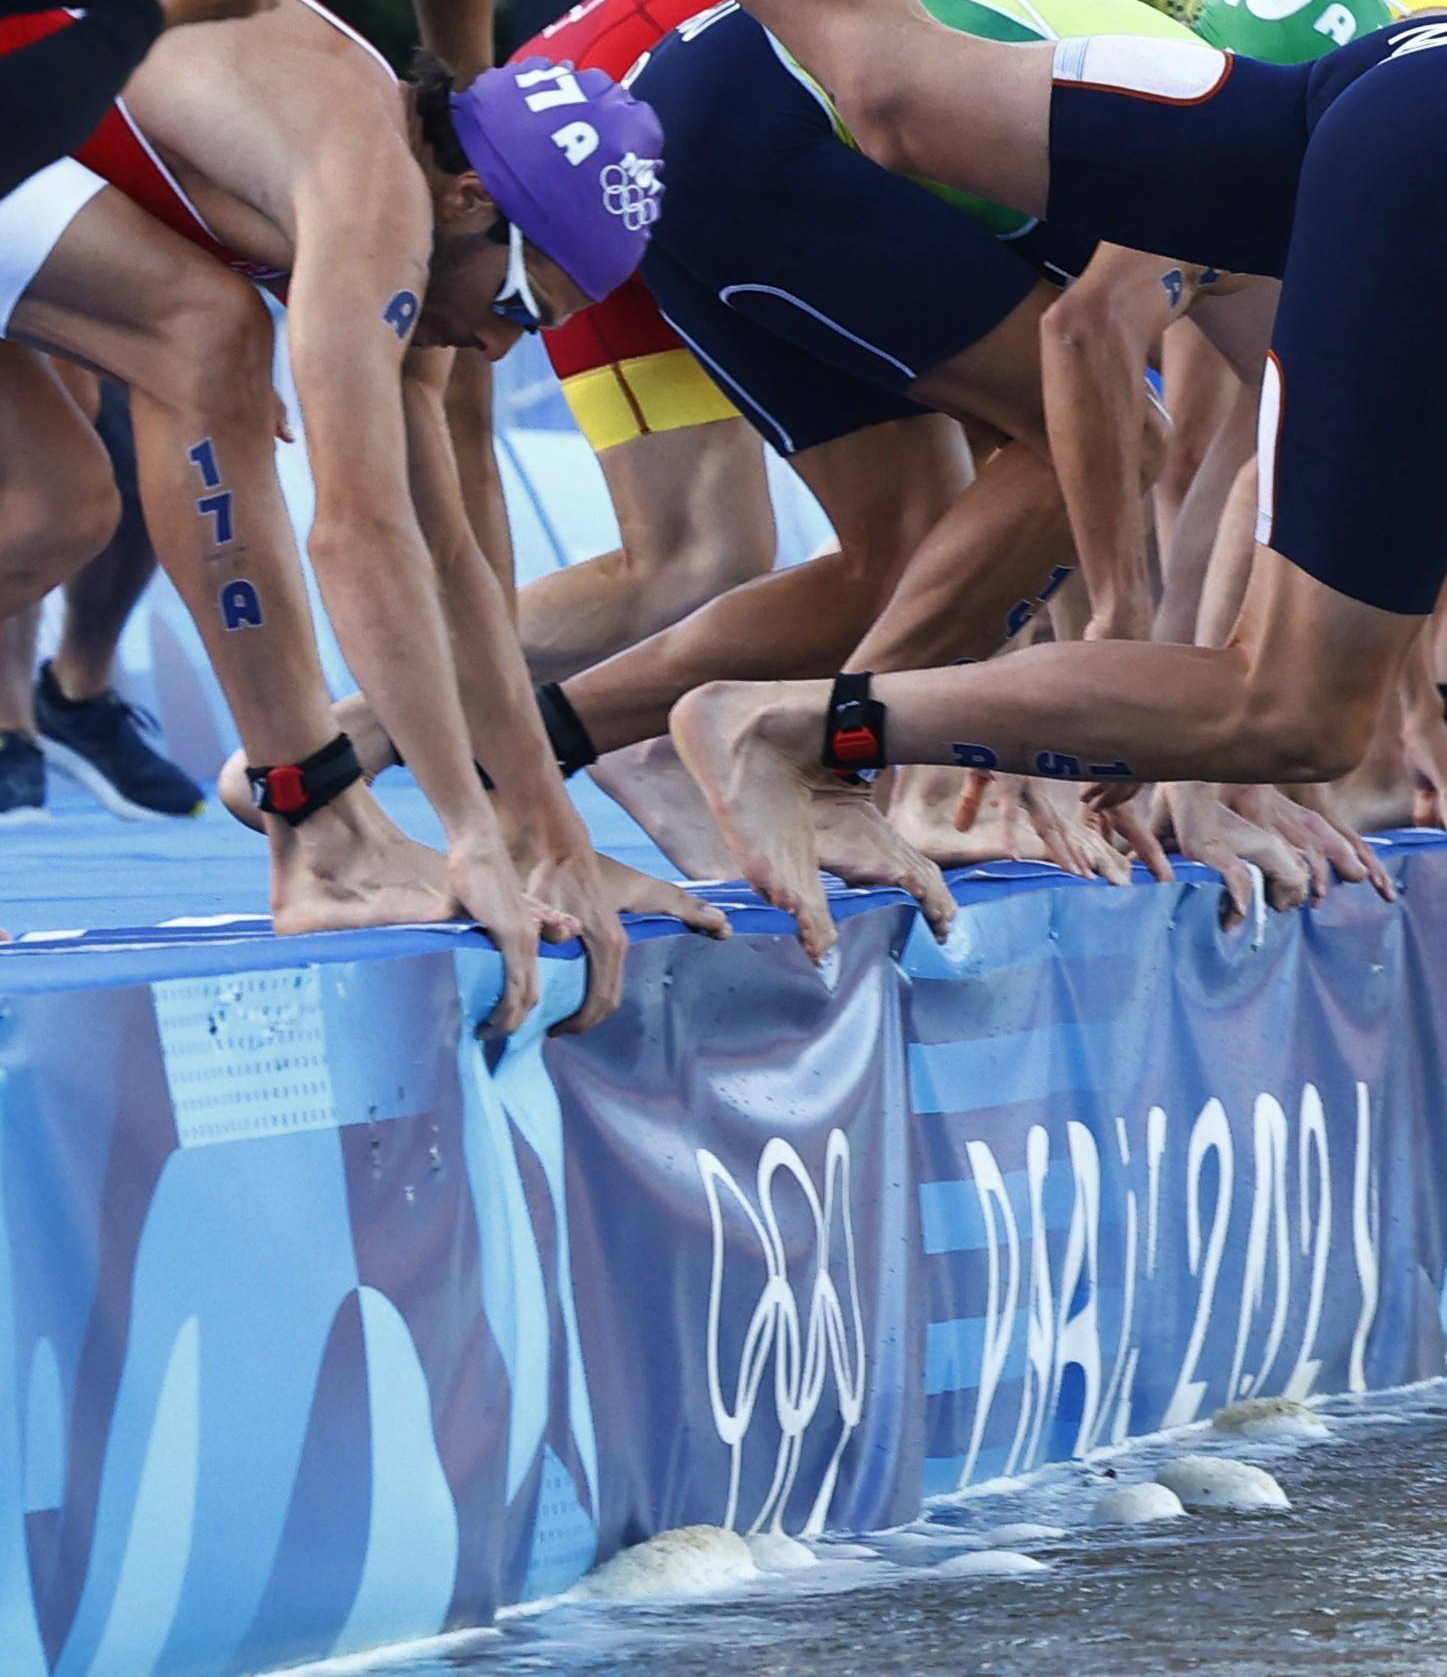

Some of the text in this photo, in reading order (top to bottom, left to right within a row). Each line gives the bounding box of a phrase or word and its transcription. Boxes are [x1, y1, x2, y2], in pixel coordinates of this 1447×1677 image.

[1312, 2, 1358, 47] A
[515, 66, 589, 113] 17
[550, 121, 600, 166] A
[383, 289, 419, 340] A
[221, 578, 263, 630] A
